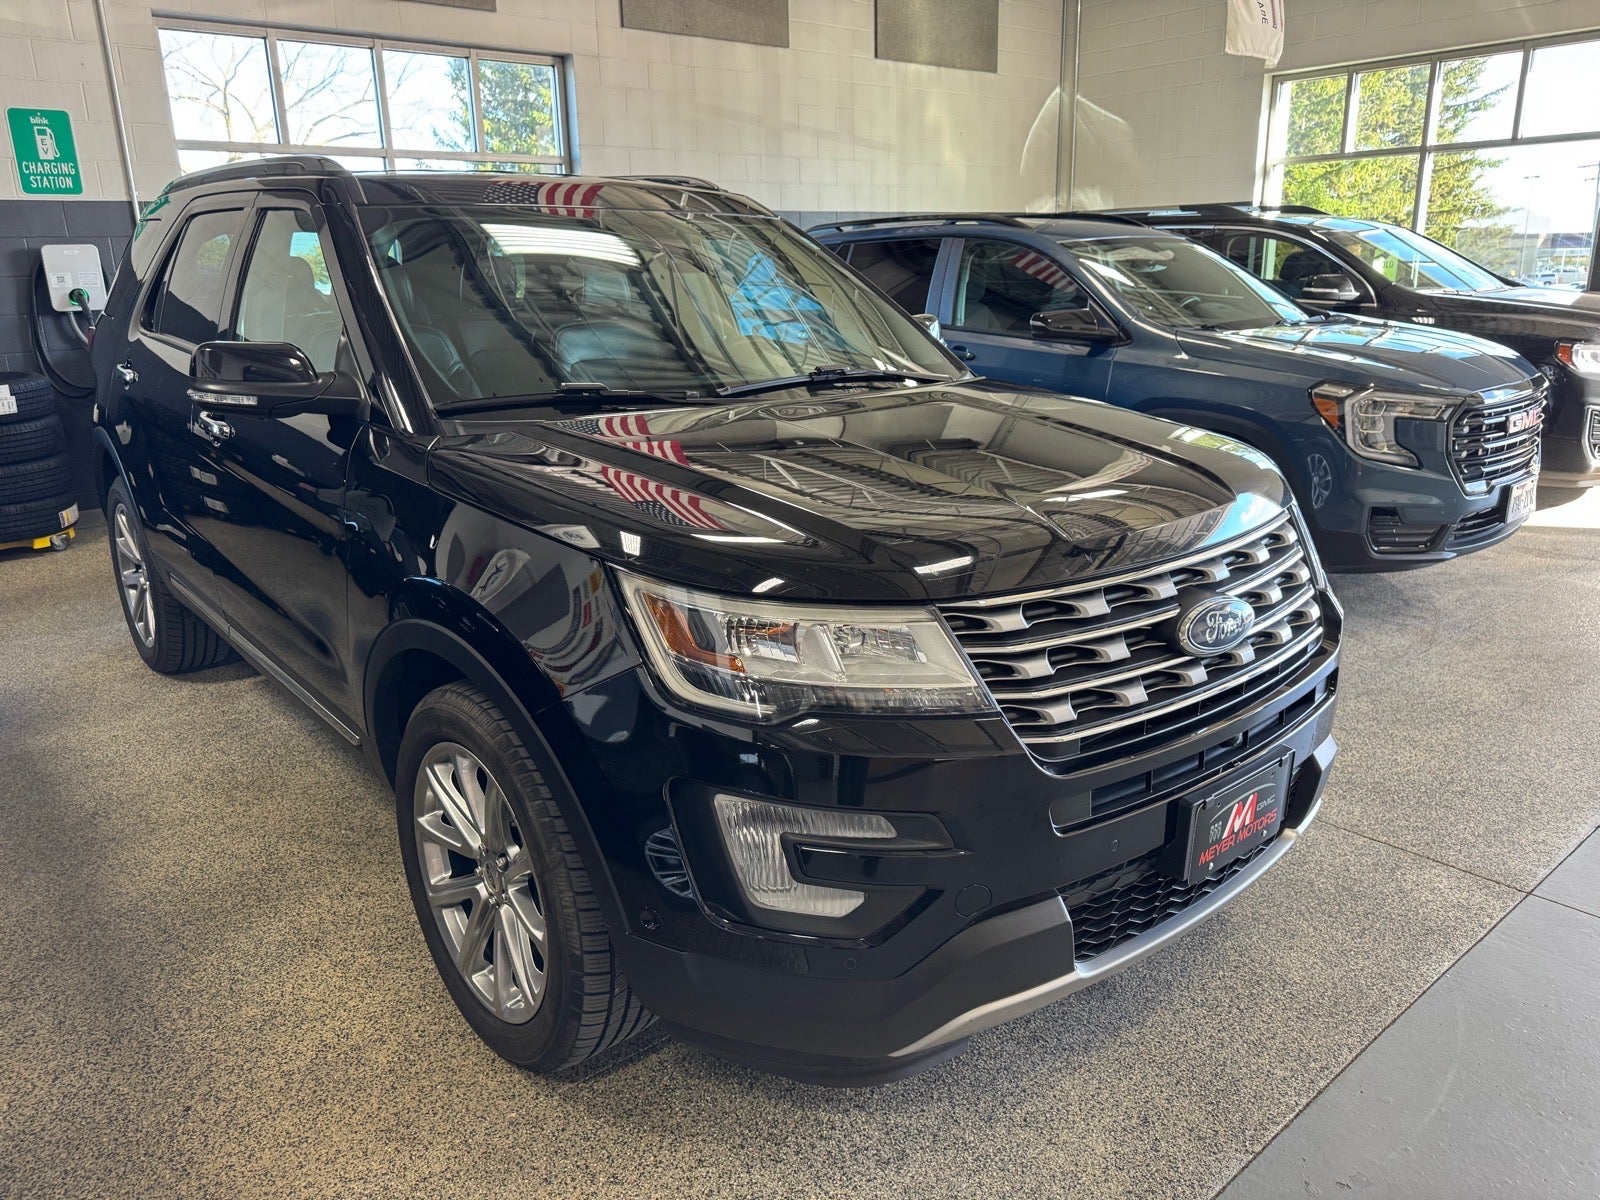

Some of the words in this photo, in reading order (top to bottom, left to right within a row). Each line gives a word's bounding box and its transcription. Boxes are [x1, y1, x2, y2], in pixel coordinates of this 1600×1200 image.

[29, 112, 49, 125] blink
[22, 161, 76, 175] CHARGING
[30, 175, 74, 189] STATION
[1508, 407, 1542, 434] GMC
[1205, 606, 1245, 645] Ford
[1256, 794, 1276, 812] GMC
[1198, 835, 1236, 867] MEYER
[1237, 807, 1278, 844] MOTORS
